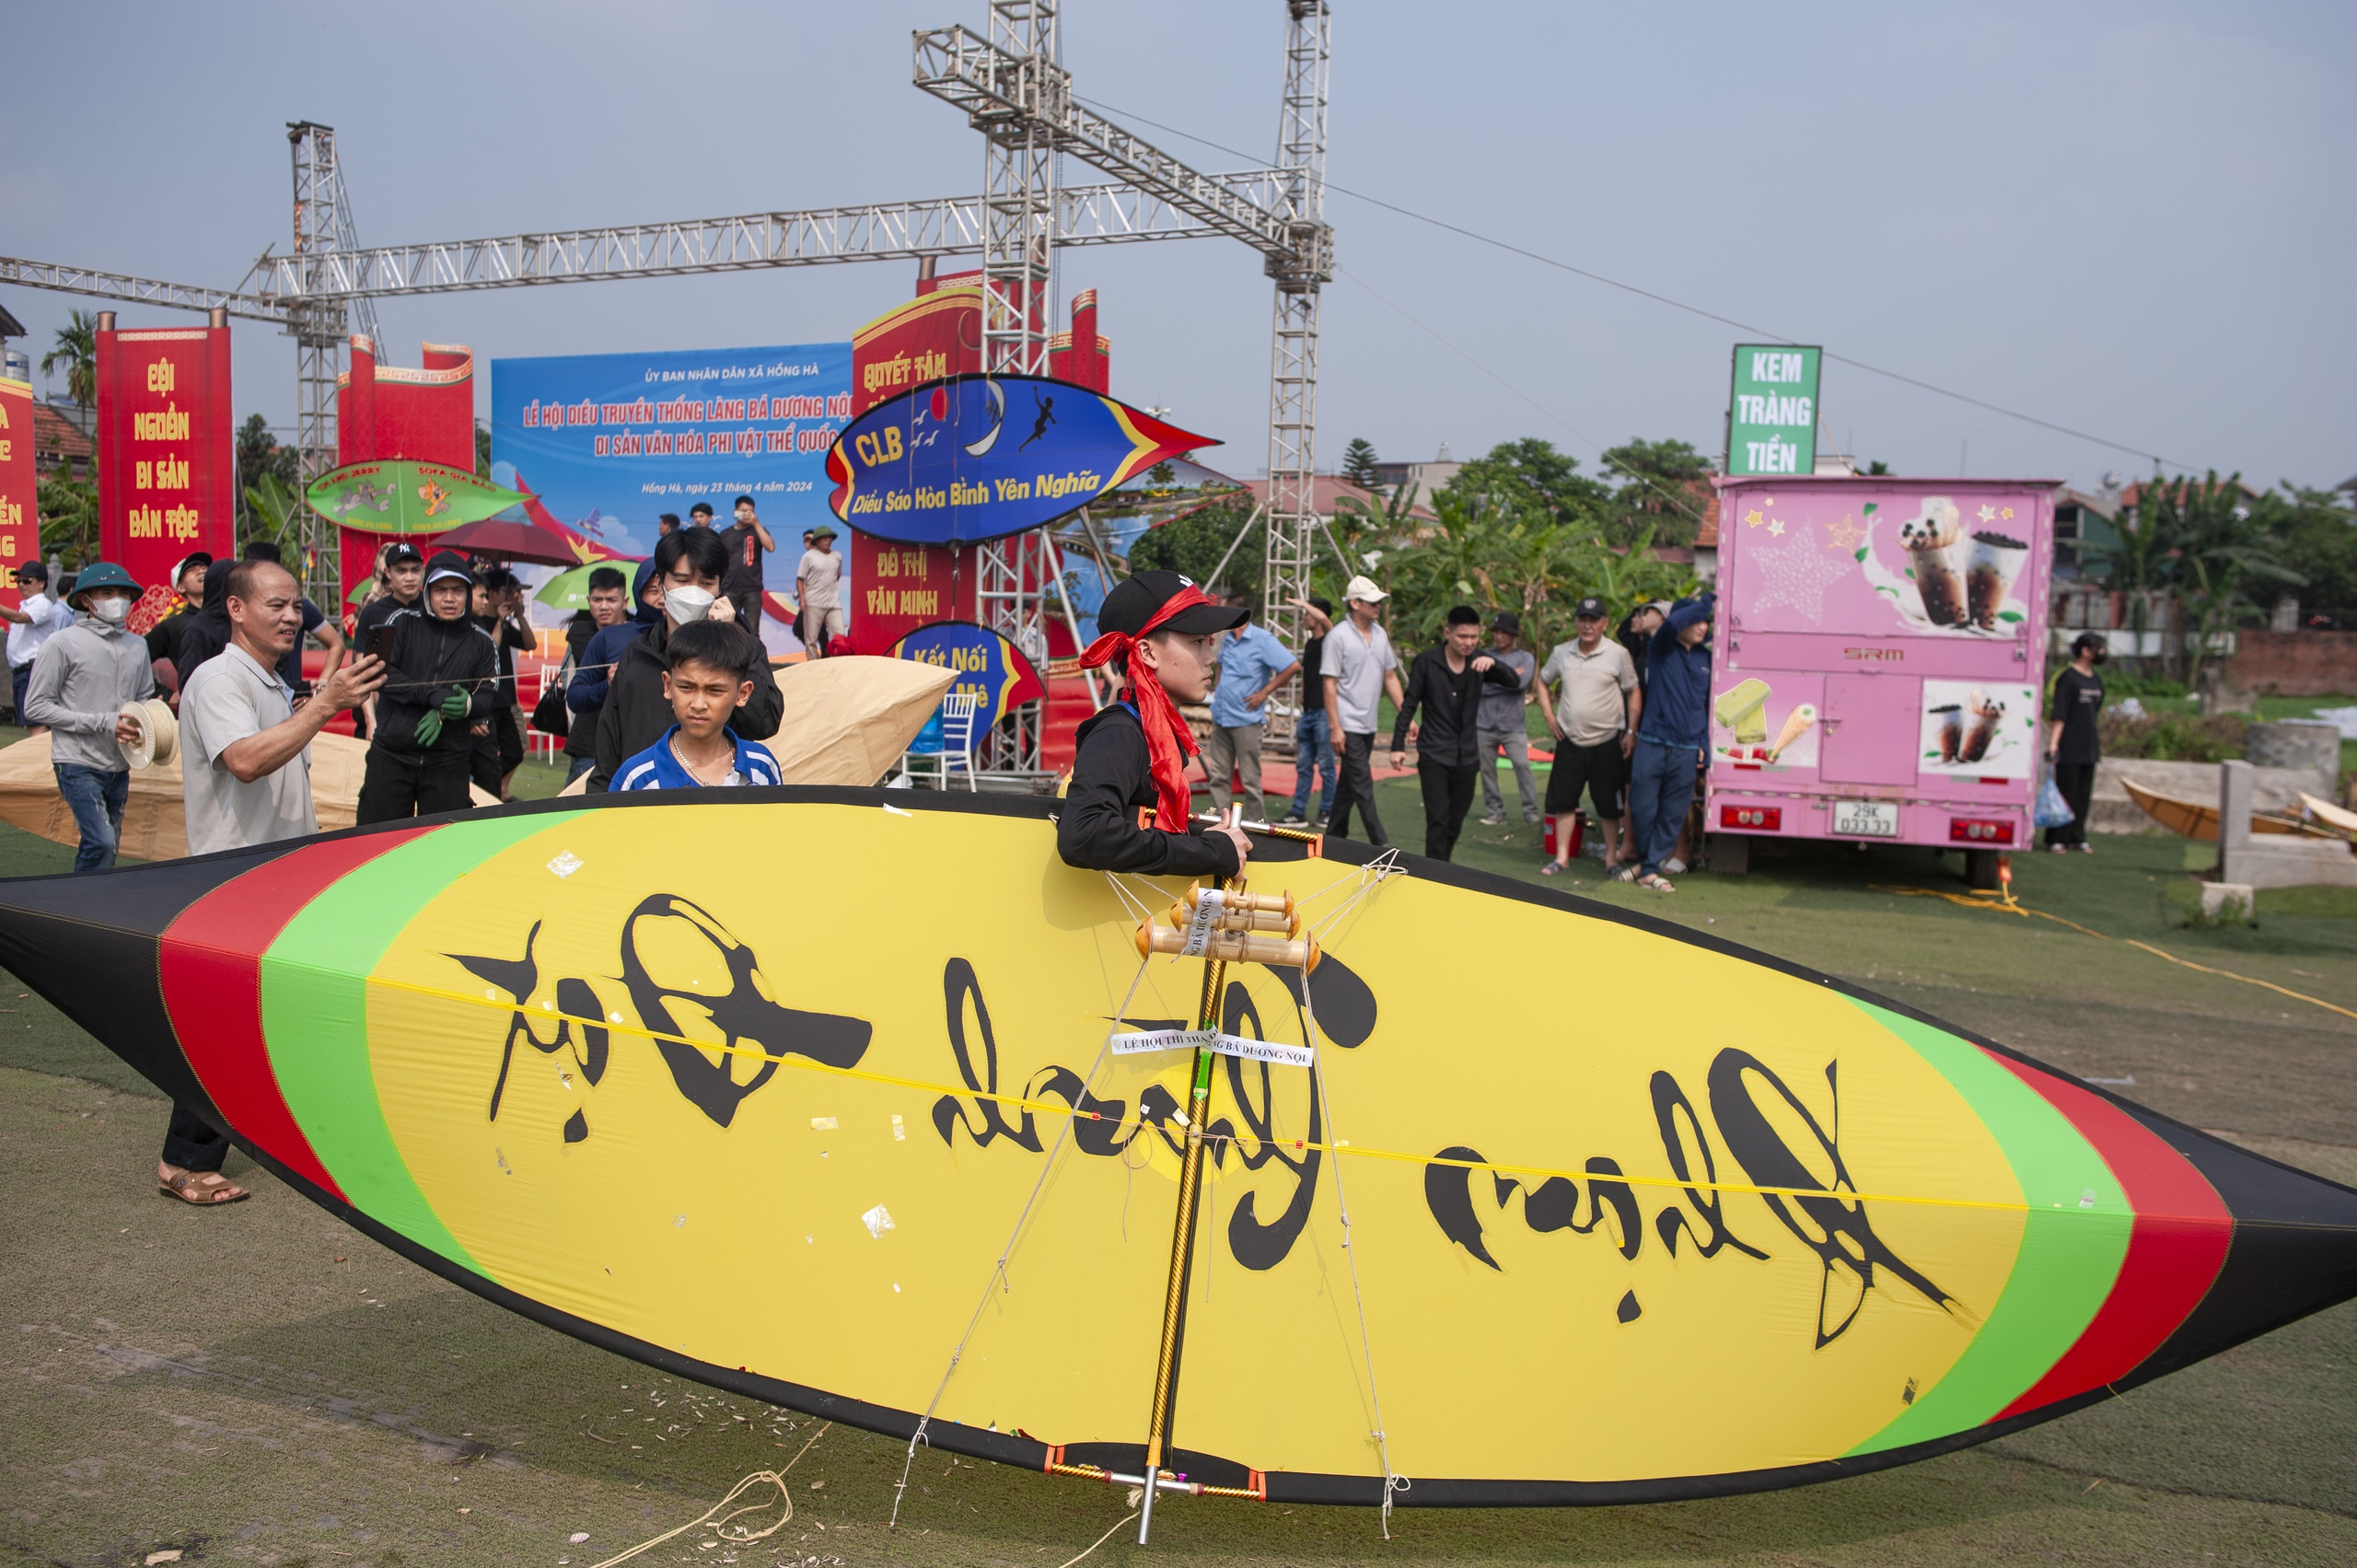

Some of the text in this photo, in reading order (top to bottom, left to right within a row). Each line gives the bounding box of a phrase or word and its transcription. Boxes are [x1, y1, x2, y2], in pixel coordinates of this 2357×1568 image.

[147, 356, 175, 398] CỘI
[644, 367, 660, 383] ỦY
[662, 370, 685, 382] BAN
[688, 366, 719, 381] NHÂN
[722, 366, 746, 379] DÂN
[748, 365, 764, 378] XÃ
[864, 349, 946, 393] QUYẾT TÂM
[1751, 352, 1803, 383] KEM
[523, 399, 540, 427] LỄ
[541, 401, 565, 431] HỘI
[656, 394, 704, 424] THỐNG
[706, 396, 746, 422] LÀNG
[748, 394, 769, 420] BÁ
[772, 395, 823, 419] DƯƠNG
[1737, 389, 1812, 426] TRÀNG
[595, 435, 610, 458] DI
[612, 428, 641, 458] SẢN
[644, 429, 673, 456] VĂN
[675, 429, 704, 455] HÓA
[707, 431, 733, 455] PHI
[736, 427, 763, 458] VẬT
[766, 423, 796, 453] THỂ
[855, 425, 903, 467] CLB
[1747, 433, 1797, 473] TIỀN
[157, 452, 190, 489] SẢN
[418, 466, 447, 477] SOFA
[685, 483, 709, 495] ngày
[711, 482, 723, 493] 23
[725, 482, 752, 494] tháng
[755, 482, 761, 492] 4
[763, 481, 784, 492] năm
[786, 481, 813, 493] 2024
[885, 488, 911, 512] Sáo
[915, 486, 946, 509] Hòa
[950, 476, 990, 505] Bình
[994, 478, 1030, 502] Yên
[1035, 470, 1101, 499] Nghĩa
[166, 503, 199, 545] TỘC
[877, 547, 927, 582] ĐÔ THỊ
[866, 585, 937, 615] VĂN MINH
[951, 644, 987, 672] Nối
[1852, 803, 1880, 819] 29K
[1164, 1035, 1184, 1045] THI
[1225, 1040, 1240, 1052] BÁ
[1243, 1044, 1283, 1059] DƯƠNG
[1285, 1051, 1306, 1063] NỘI
